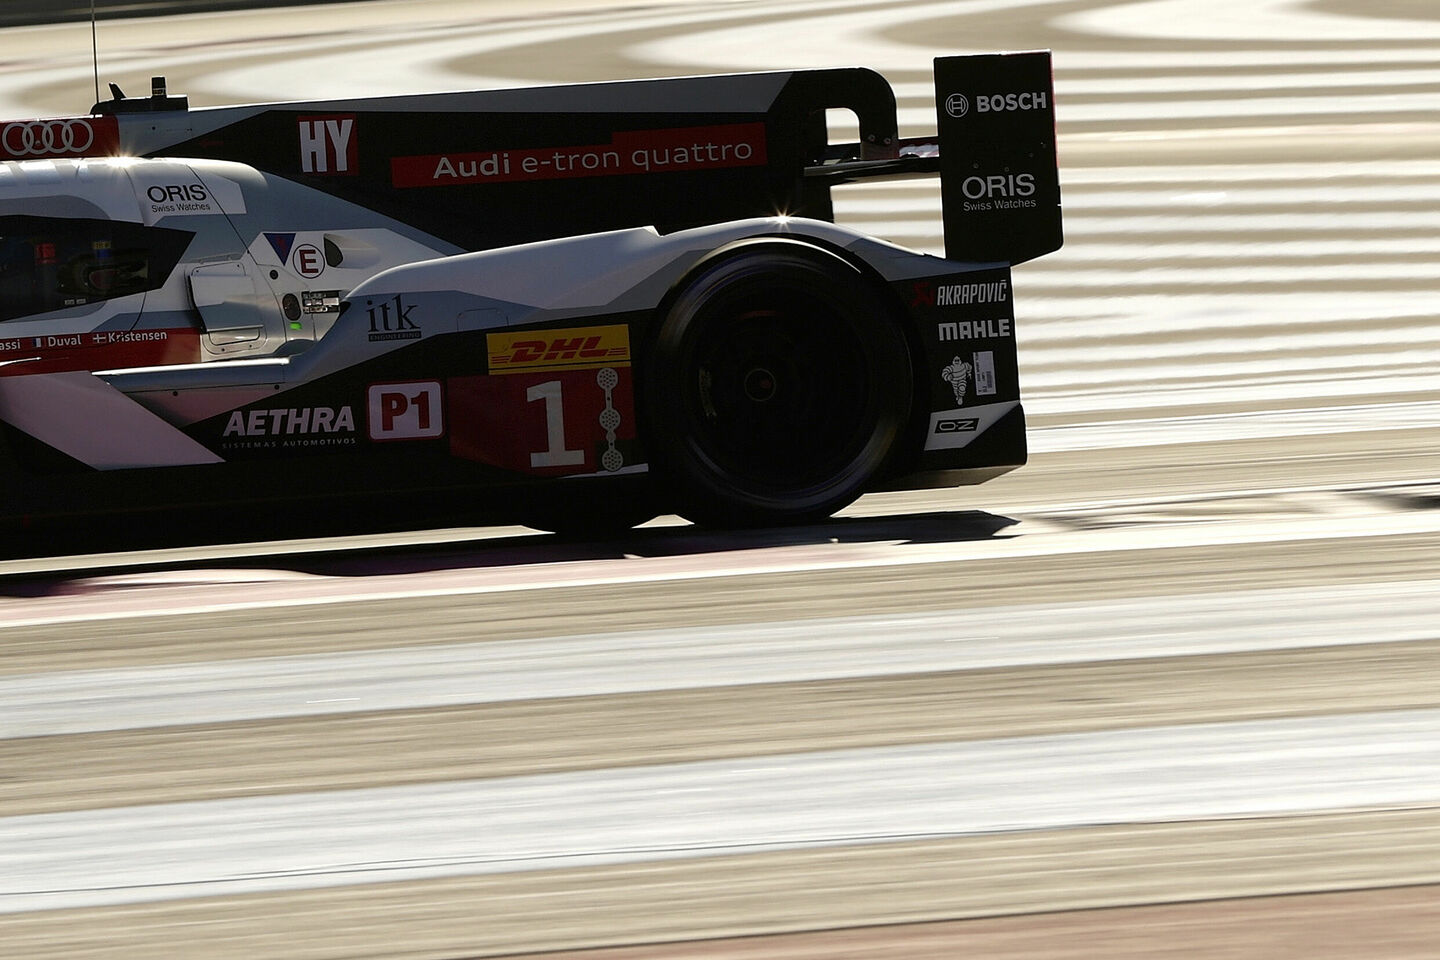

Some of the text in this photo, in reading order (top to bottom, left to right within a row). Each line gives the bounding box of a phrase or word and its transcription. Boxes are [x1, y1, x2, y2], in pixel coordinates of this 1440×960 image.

[976, 92, 1047, 112] BOSCH
[298, 119, 353, 173] HY
[433, 140, 754, 179] Audi e-tron quattro
[147, 184, 207, 203] ORIS
[961, 173, 1036, 200] ORIS
[151, 203, 210, 212] Swiss Watches
[963, 198, 1037, 212] Swiss Watches
[299, 249, 319, 273] E
[365, 294, 421, 332] itk
[48, 334, 82, 347] Duval
[108, 330, 168, 343] Kristensen
[938, 318, 1010, 341] MAHLE
[511, 336, 609, 362] DHL
[222, 405, 356, 437] AETHRA
[381, 391, 430, 431] P1
[526, 380, 585, 468] 1
